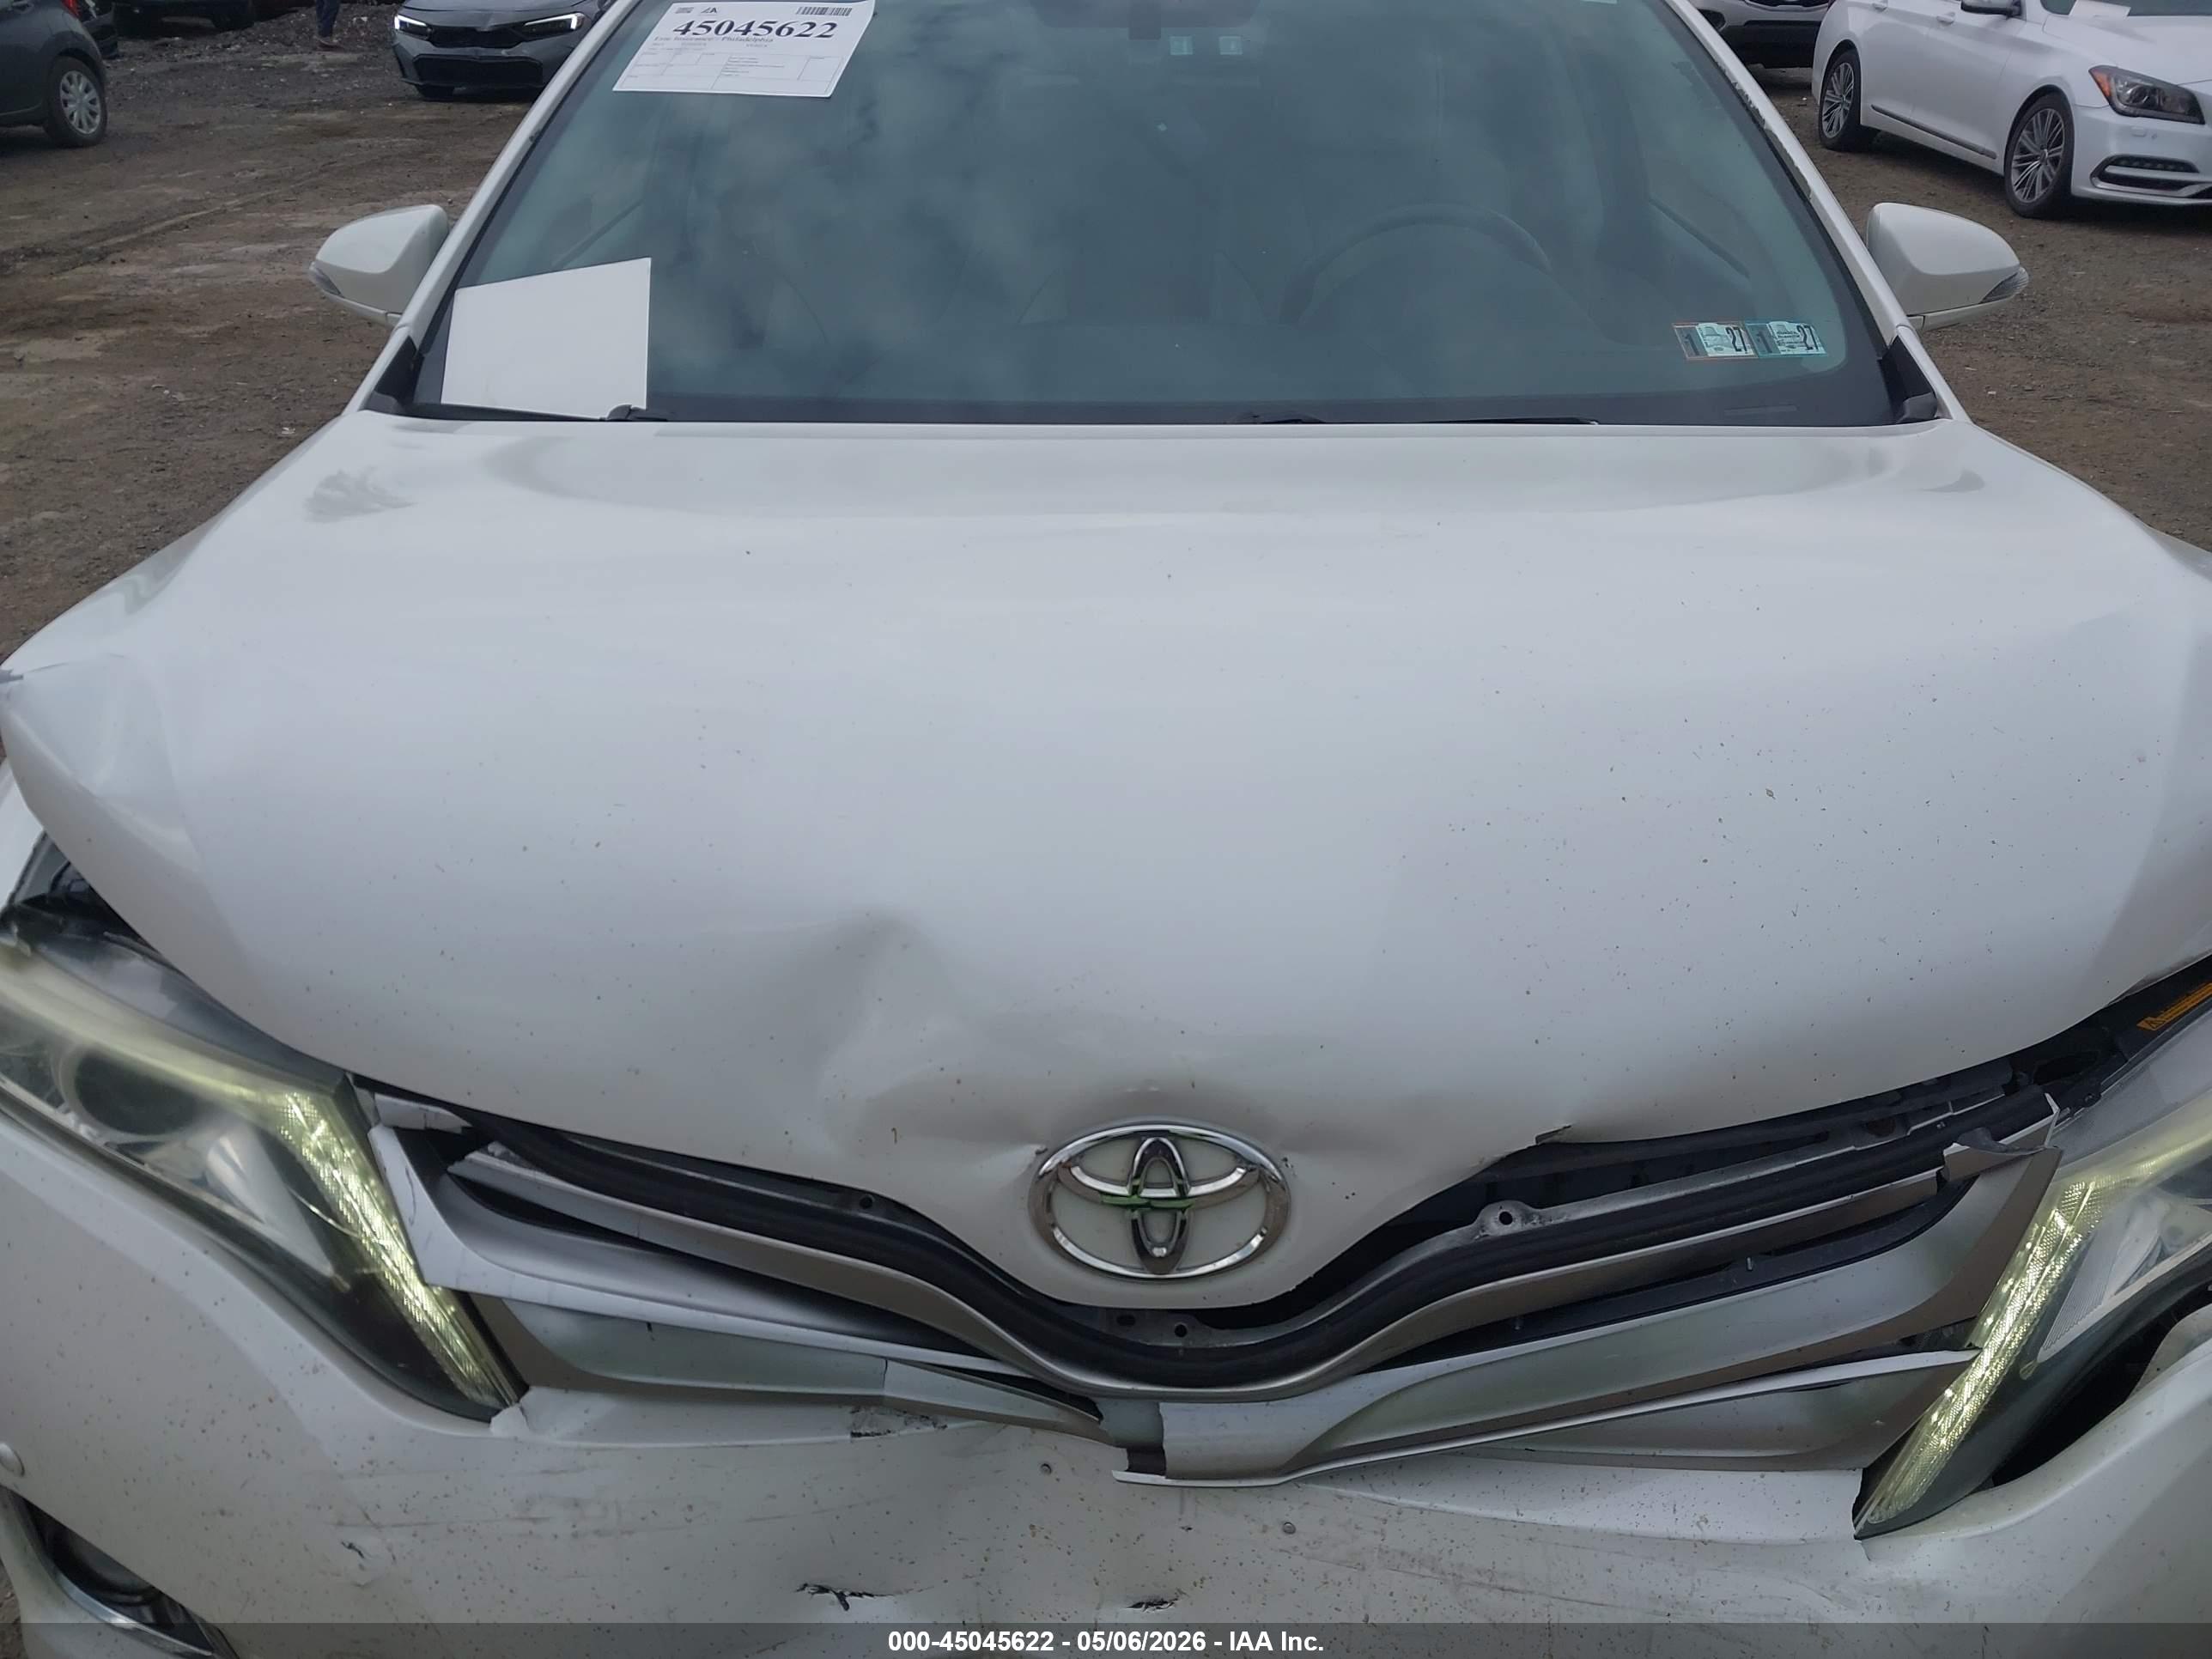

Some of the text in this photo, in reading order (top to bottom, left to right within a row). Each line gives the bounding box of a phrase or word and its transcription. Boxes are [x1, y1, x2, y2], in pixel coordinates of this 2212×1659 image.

[673, 19, 838, 39] 45045622
[1725, 326, 1748, 354] 27
[1796, 325, 1819, 351] 27
